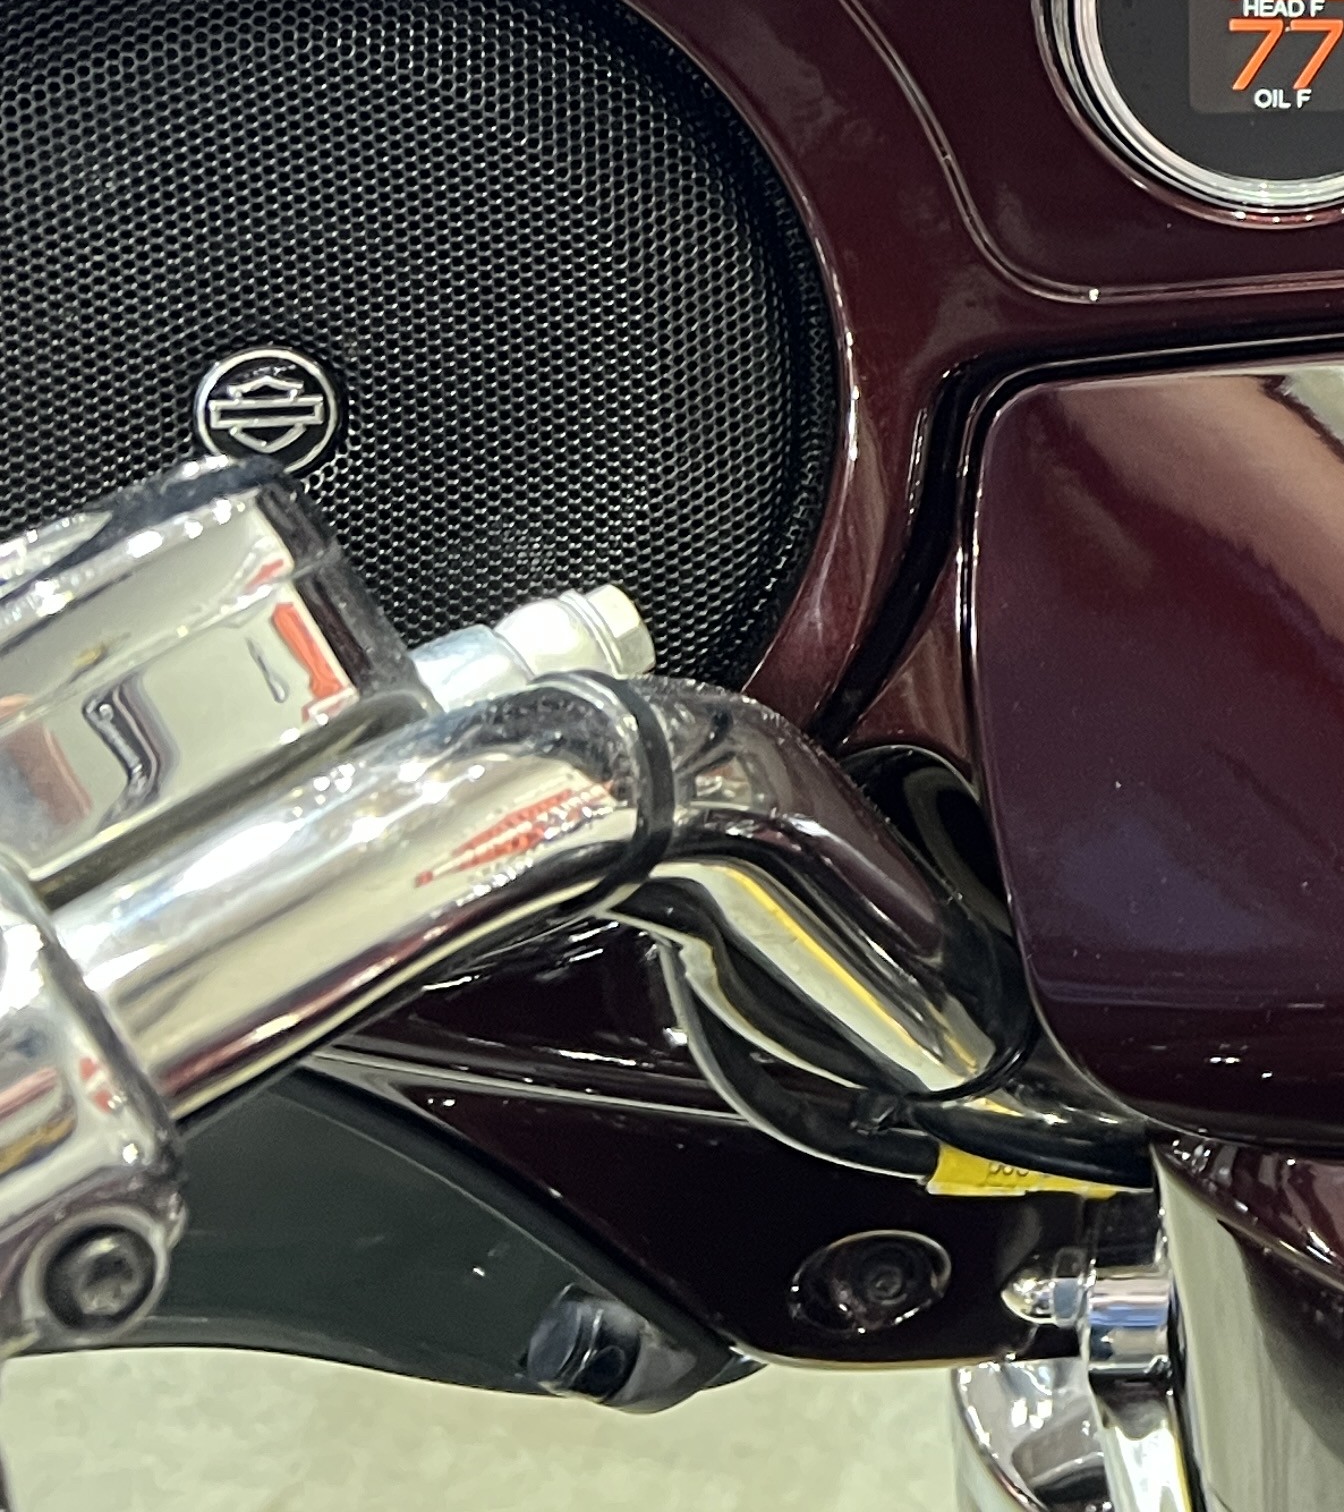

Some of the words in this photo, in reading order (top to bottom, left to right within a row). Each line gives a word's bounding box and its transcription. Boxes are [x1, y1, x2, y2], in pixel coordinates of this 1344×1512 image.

[1229, 19, 1344, 91] 77
[1254, 89, 1291, 109] OIL
[1296, 89, 1312, 109] F
